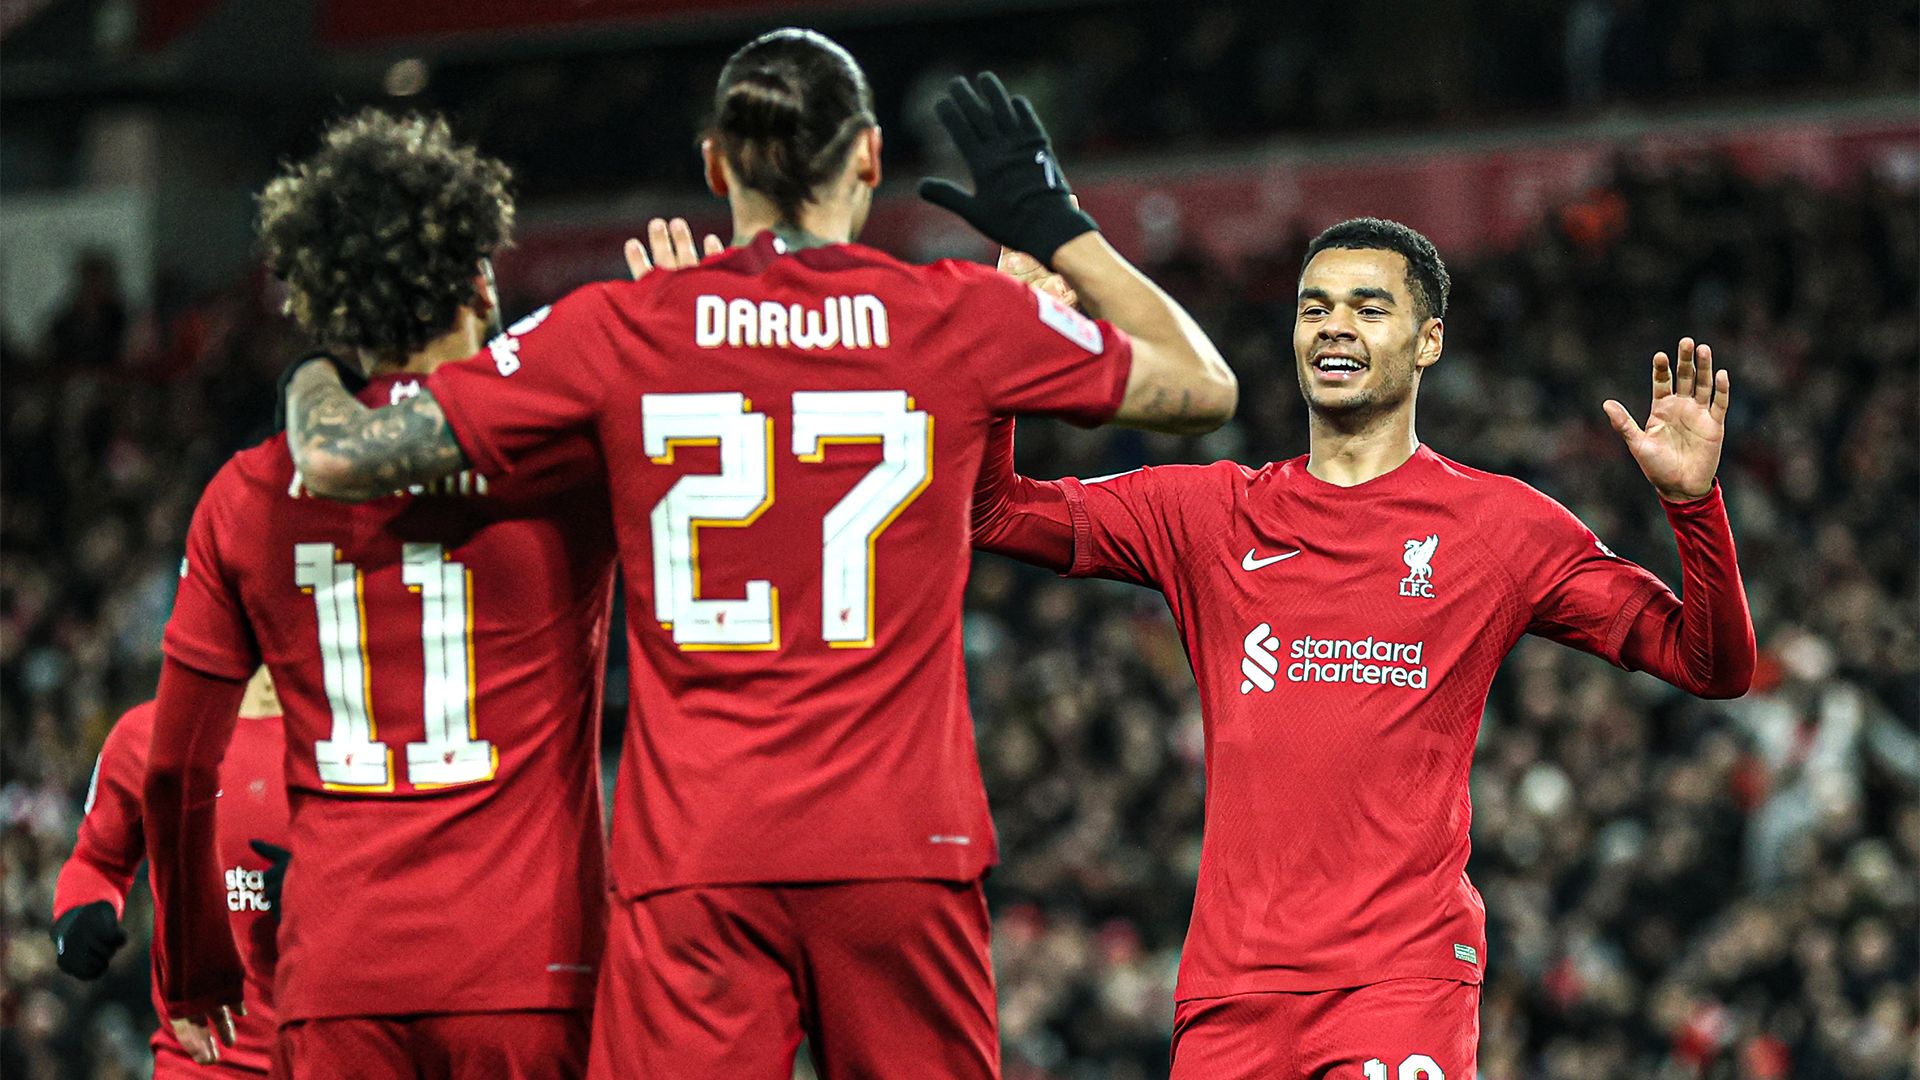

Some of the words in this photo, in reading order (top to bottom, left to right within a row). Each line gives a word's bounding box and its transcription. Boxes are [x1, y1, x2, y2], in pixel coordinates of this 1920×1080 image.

[695, 294, 890, 350] DARWIN
[641, 390, 934, 651] 27
[294, 543, 499, 793] 11
[1287, 658, 1428, 689] chartered
[1290, 635, 1424, 665] standard
